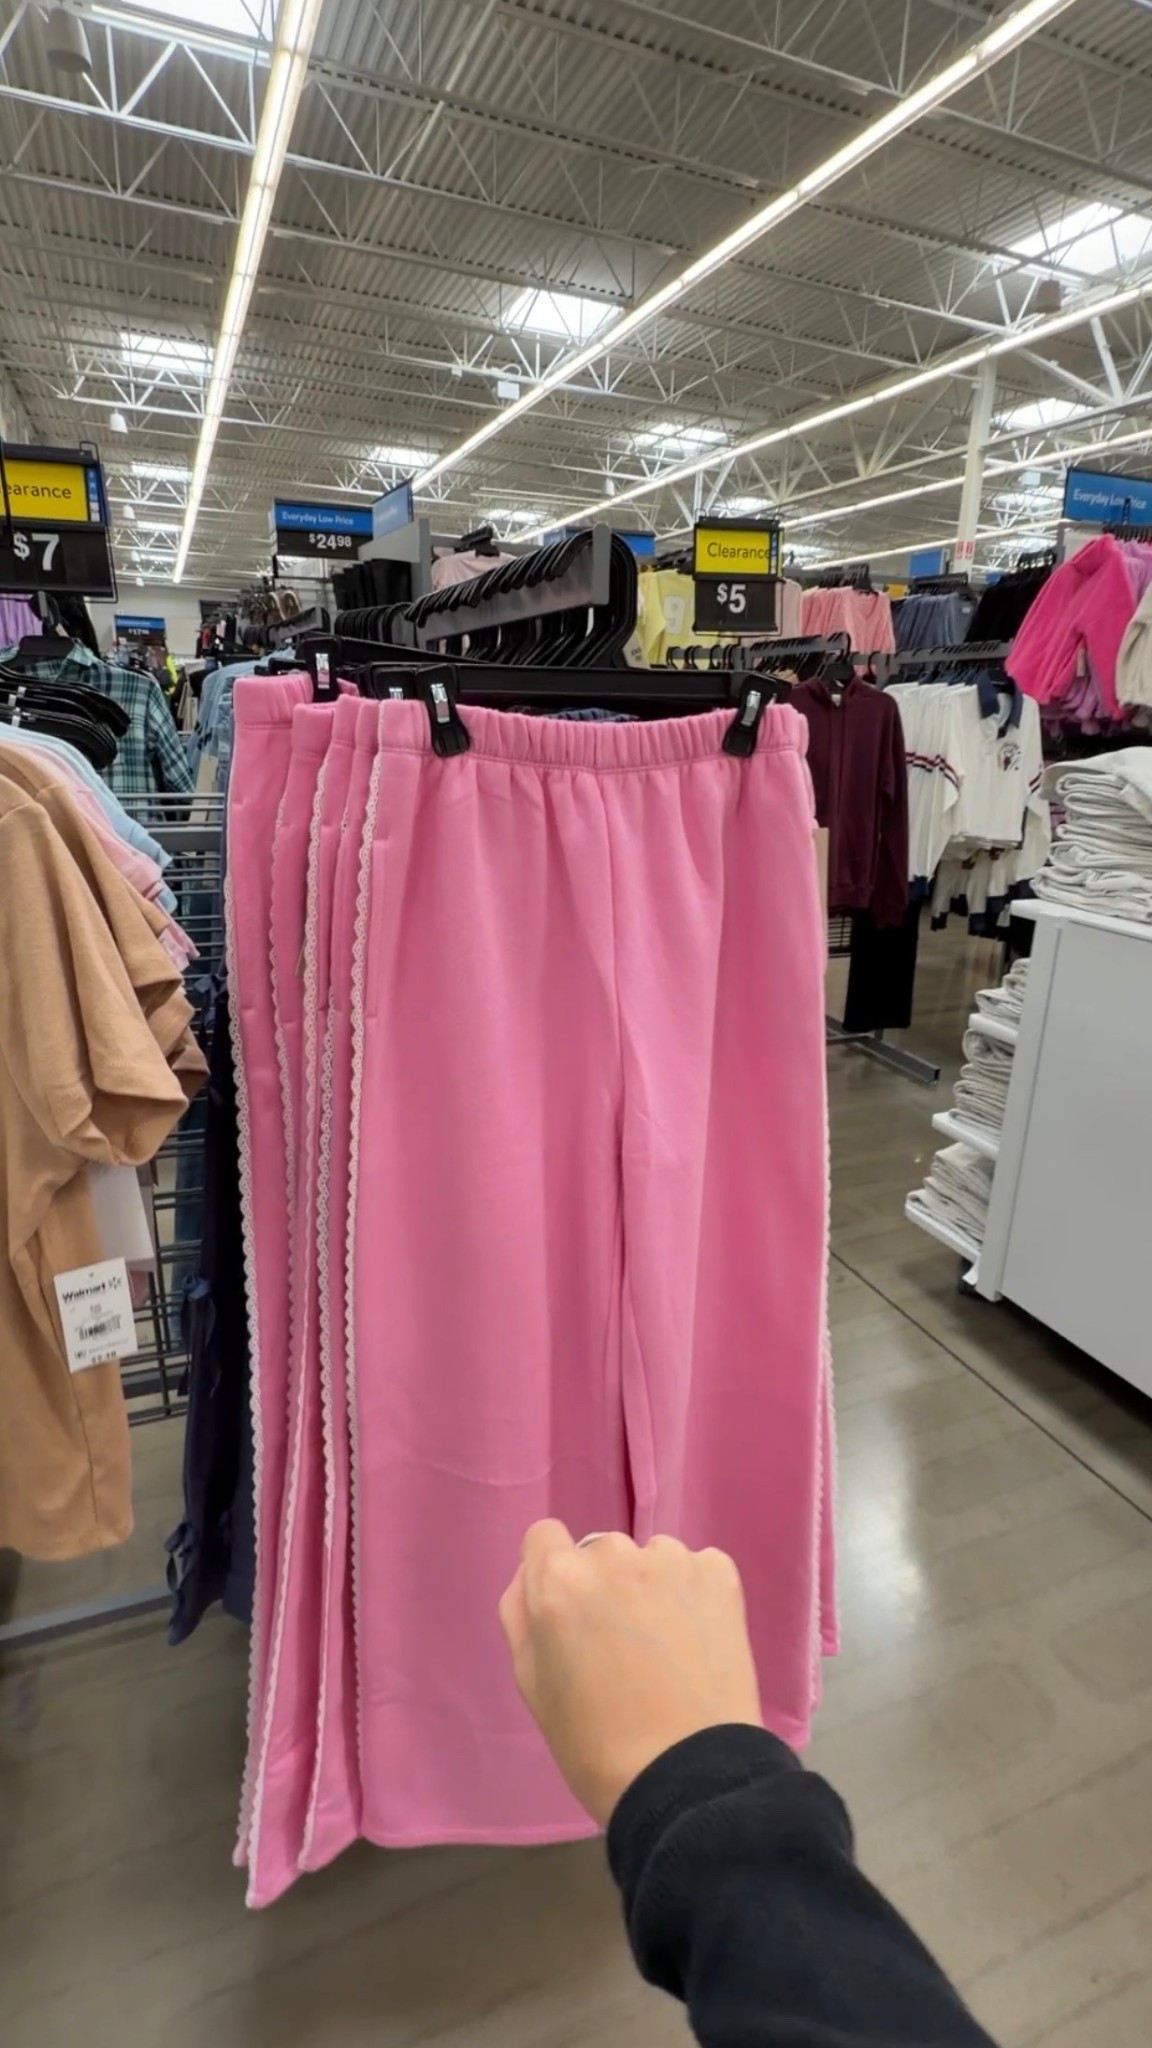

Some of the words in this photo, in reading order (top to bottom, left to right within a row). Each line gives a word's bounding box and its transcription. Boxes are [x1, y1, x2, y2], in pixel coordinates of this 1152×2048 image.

[4, 484, 72, 499] earance
[281, 511, 317, 524] Everyday
[318, 513, 334, 523] Low
[334, 514, 355, 526] Price
[13, 531, 60, 571] $7
[707, 541, 771, 560] Clearance
[716, 582, 747, 614] $5
[62, 1281, 107, 1303] Walmart
